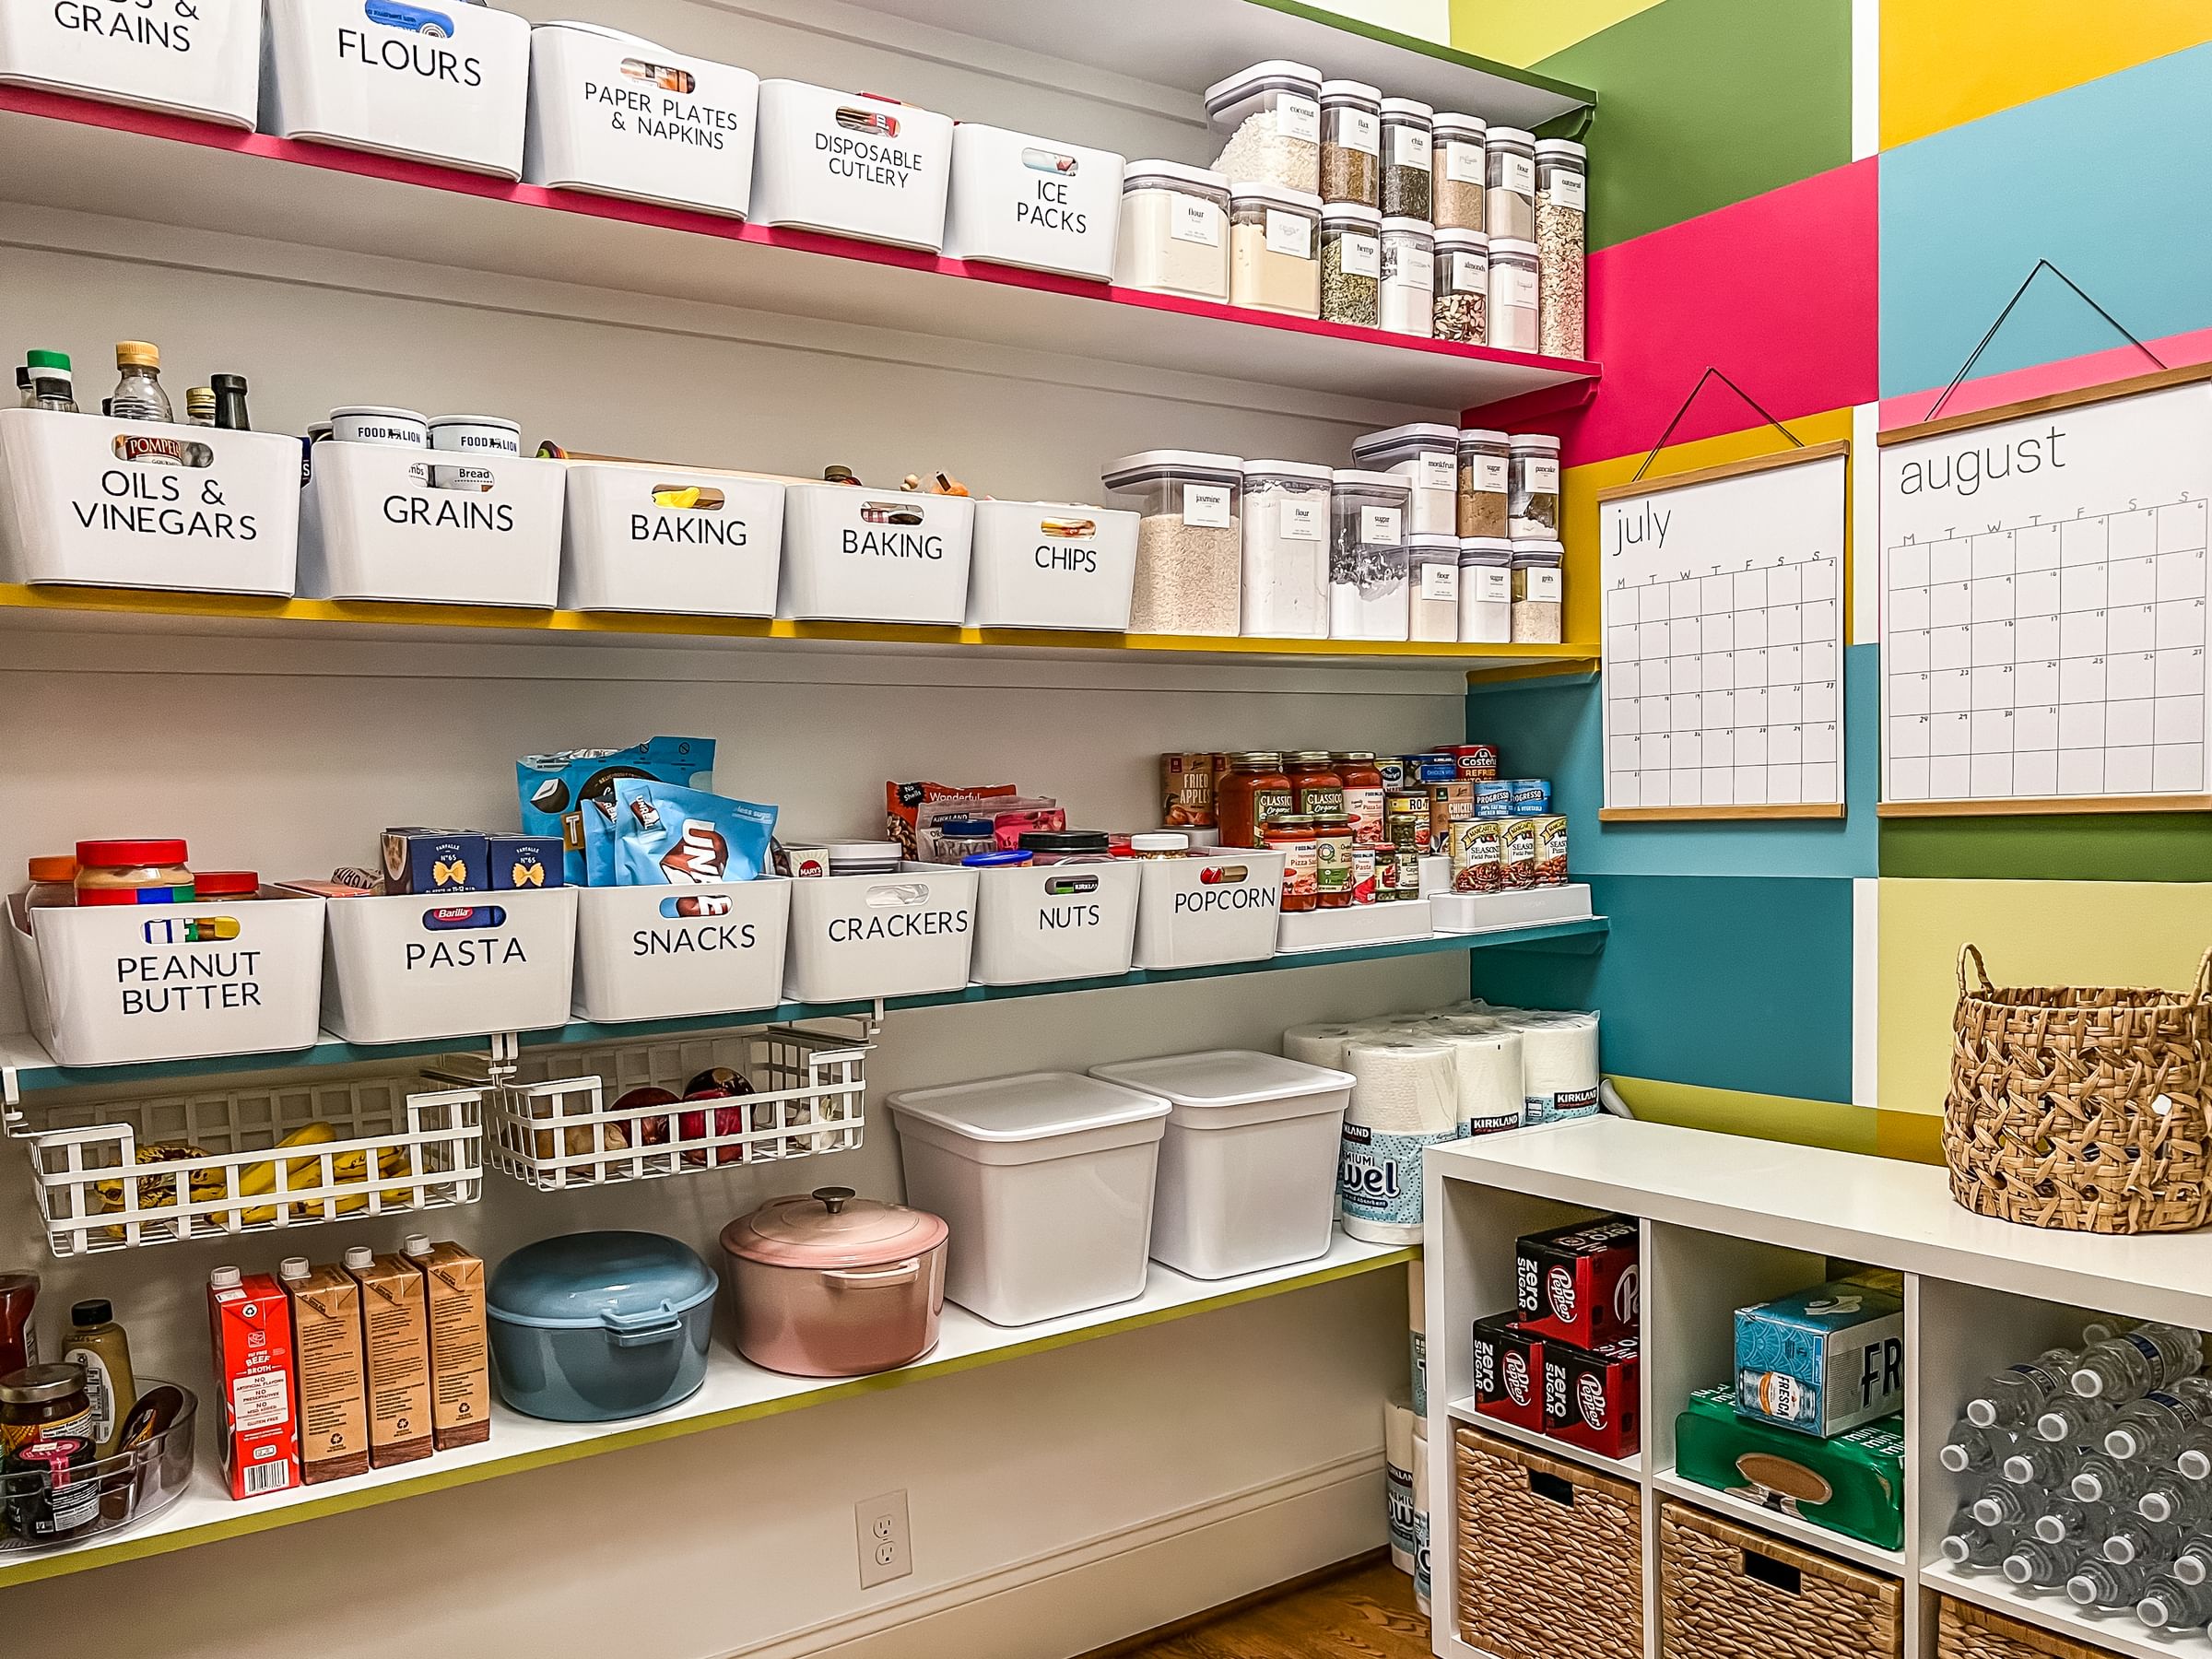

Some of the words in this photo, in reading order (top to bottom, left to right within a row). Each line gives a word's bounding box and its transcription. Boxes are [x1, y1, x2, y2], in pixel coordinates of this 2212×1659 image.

[54, 1, 191, 52] GRAINS
[338, 28, 481, 87] FLOURS
[584, 82, 653, 113] PAPER
[663, 98, 737, 131] PLATES
[1290, 106, 1314, 118] coconut
[611, 112, 627, 131] &
[638, 116, 724, 150] NAPKINS
[1358, 119, 1369, 129] flax
[815, 133, 923, 171] DISPOSABLE
[1411, 137, 1424, 146] chia
[829, 158, 909, 189] CUTLERY
[1037, 180, 1068, 205] ICE
[1017, 202, 1087, 234] PACKS
[1188, 207, 1204, 218] flour
[1357, 243, 1374, 254] hemp
[1464, 261, 1486, 272] almonds
[358, 427, 386, 439] FOOD
[402, 430, 421, 444] LION
[460, 435, 488, 448] FOOD
[502, 439, 518, 453] LION
[459, 468, 490, 478] Bread
[1487, 465, 1501, 473] sugar
[1900, 426, 2066, 496] august
[101, 470, 180, 501] OILS
[201, 479, 226, 506] &
[1195, 494, 1221, 504] jasmine
[71, 500, 257, 540] VINEGARS
[383, 496, 513, 532] GRAINS
[1295, 508, 1309, 517] flour
[1903, 533, 1915, 546] M
[1944, 527, 1956, 540] T
[1987, 520, 2001, 533] W
[2029, 515, 2042, 527] T
[2078, 507, 2085, 520] F
[2129, 498, 2138, 511] S
[2178, 492, 2189, 502] S
[631, 514, 747, 546] BAKING
[1612, 500, 1671, 556] july
[842, 529, 943, 560] BAKING
[1035, 546, 1097, 573] CHIPS
[1618, 578, 1625, 588] M
[1649, 575, 1658, 585] T
[1680, 570, 1691, 580] W
[1711, 566, 1721, 575] T
[1745, 559, 1753, 571] F
[1777, 557, 1785, 566] S
[1813, 551, 1820, 561] S
[1184, 774, 1208, 788] FRIED
[903, 791, 921, 801] Shells
[930, 792, 981, 801] Wonderful
[1180, 789, 1211, 804] APPLES
[1307, 794, 1342, 804] CLASSICO
[1477, 792, 1509, 804] PROGRESSO
[636, 794, 652, 830] UNREAL
[737, 806, 753, 816] less
[800, 866, 821, 876] MARY'S
[438, 908, 469, 918] Barilla
[1175, 887, 1276, 914] POPCORN
[829, 910, 968, 942] CRACKERS
[1040, 905, 1100, 930] NUTS
[406, 937, 527, 970] PASTA
[633, 924, 755, 956] SNACKS
[118, 951, 260, 983] PEANUT
[123, 982, 262, 1015] BUTTER
[1557, 1090, 1596, 1103] KIRKLAND
[1474, 1115, 1518, 1128] KIRKLAND
[1517, 1257, 1526, 1308] SUGAR
[1550, 1268, 1572, 1319] Pepper
[246, 1355, 271, 1366] BEEF
[247, 1365, 271, 1375] BROTH
[1475, 1340, 1483, 1390] SUGAR
[1506, 1353, 1526, 1402] Pepper
[1546, 1362, 1554, 1414] SUGAR
[243, 1392, 279, 1402] PRESERVATIVES
[1580, 1374, 1602, 1426] Pepper
[1777, 1376, 1790, 1417] FRESCA
[1841, 1426, 1881, 1442] mini
[1859, 1431, 1902, 1448] mini
